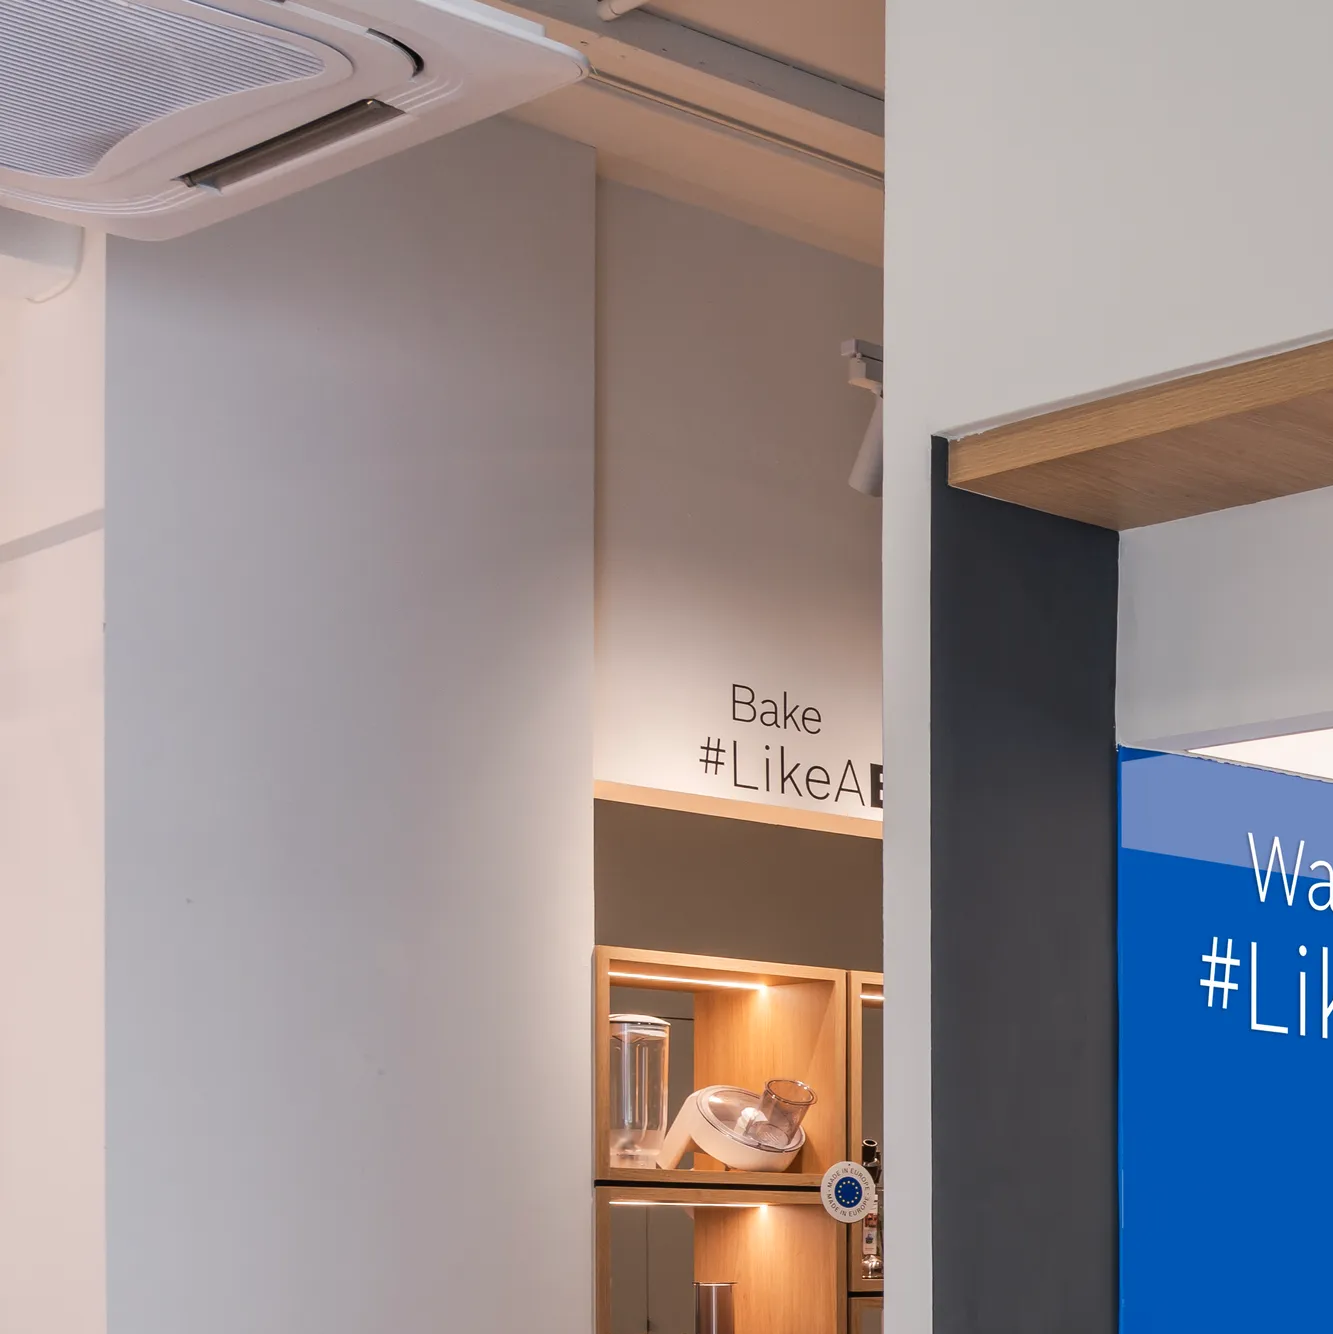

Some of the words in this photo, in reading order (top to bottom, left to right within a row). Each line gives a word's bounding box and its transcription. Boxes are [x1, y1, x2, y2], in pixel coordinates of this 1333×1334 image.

[732, 683, 822, 735] Bake
[827, 1170, 841, 1188] MADE
[850, 1168, 870, 1190] EUROPE
[827, 1194, 839, 1213] MADE
[848, 1198, 870, 1217] EUROPE
